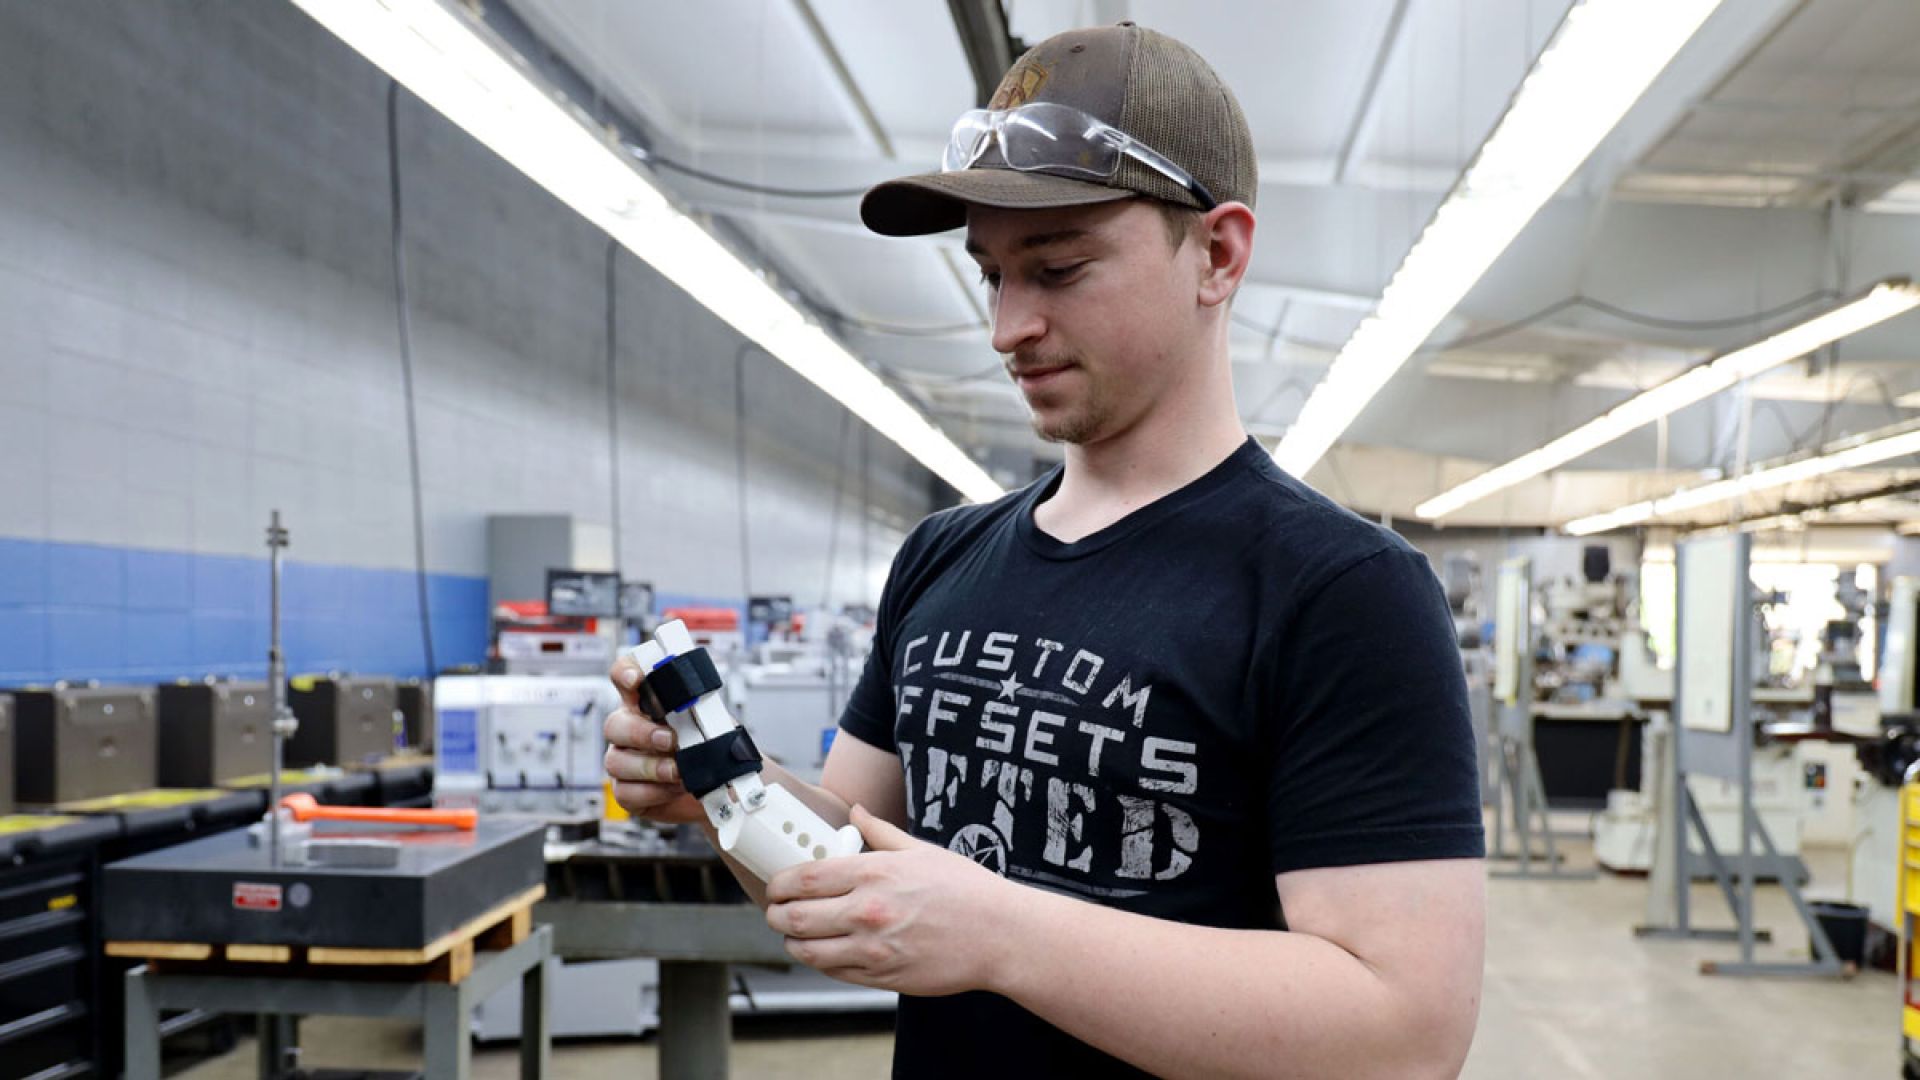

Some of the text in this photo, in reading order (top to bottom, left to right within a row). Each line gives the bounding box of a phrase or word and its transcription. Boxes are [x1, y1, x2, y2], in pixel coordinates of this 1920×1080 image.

[903, 629, 1153, 729] CUSTOM
[893, 684, 1199, 795] FFSETS
[898, 741, 1200, 881] FTED
